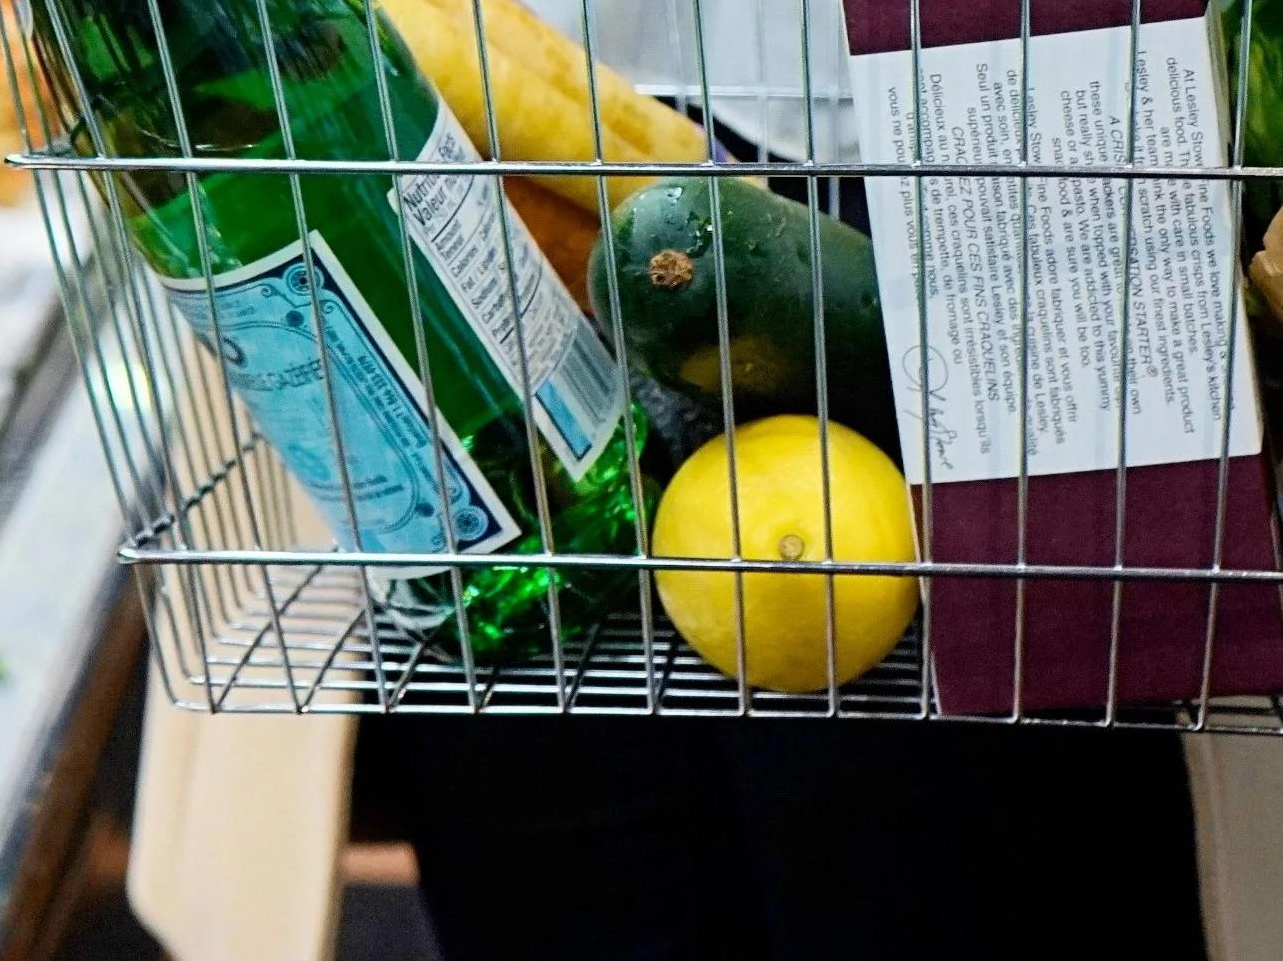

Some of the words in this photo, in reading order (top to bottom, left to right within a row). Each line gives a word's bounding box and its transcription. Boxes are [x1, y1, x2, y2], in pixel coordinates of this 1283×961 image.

[975, 62, 991, 92] Seul
[1006, 68, 1020, 86] de
[1166, 56, 1185, 113] delicious
[1182, 68, 1196, 82] At
[887, 86, 900, 117] vous
[929, 73, 948, 131] Délicieux
[980, 94, 991, 111] un
[993, 81, 1006, 111] avec
[1075, 89, 1089, 110] but
[1088, 80, 1105, 115] these
[1141, 95, 1154, 106] &
[1182, 85, 1202, 128] Lesley
[891, 119, 903, 136] ne
[1060, 89, 1078, 137] cheese
[1108, 114, 1122, 125] A
[1142, 108, 1157, 130] her
[915, 98, 939, 185] accompags
[937, 133, 949, 151] au
[980, 113, 1000, 159] produit
[995, 114, 1013, 145] soin,
[1075, 112, 1094, 147] really
[1091, 118, 1111, 162] unique
[1160, 125, 1172, 148] are
[1173, 115, 1189, 148] food.
[1001, 148, 1013, 165] en
[1029, 131, 1045, 164] Stow
[1051, 136, 1064, 165] snac
[1066, 139, 1077, 152] or
[1145, 133, 1162, 166] team
[1178, 149, 1195, 190] The
[411, 184, 450, 227] Valeur
[899, 189, 916, 217] plus
[930, 188, 944, 205] de
[973, 176, 993, 223] pouvait
[1087, 186, 1104, 221] when
[1101, 176, 1118, 219] ackers
[1138, 187, 1155, 234] scratch
[1168, 189, 1183, 216] with
[947, 203, 959, 227] ces
[960, 197, 978, 240] POUR
[1039, 205, 1056, 245] Foods
[1061, 208, 1074, 218] &
[1154, 203, 1169, 225] the
[1183, 192, 1202, 247] fabulous
[1200, 206, 1217, 246] Foods
[905, 220, 918, 249] vous
[930, 207, 953, 271] trempette,
[993, 209, 1014, 261] fabriqué
[1062, 221, 1074, 242] are
[1077, 218, 1091, 241] We
[1107, 221, 1119, 243] are
[1155, 227, 1173, 254] only
[1172, 218, 1185, 247] care
[948, 229, 970, 294] craquelins
[967, 242, 982, 273] CES
[982, 225, 1001, 282] satisfaire
[1027, 232, 1046, 286] fabuleux
[1066, 245, 1079, 274] sure
[1080, 243, 1092, 264] are
[1090, 224, 1110, 268] topped
[1142, 236, 1160, 271] using
[1176, 250, 1189, 262] in
[1205, 249, 1217, 268] we
[1044, 247, 1061, 284] adore
[1108, 245, 1126, 279] great
[1159, 256, 1174, 283] way
[1188, 248, 1207, 288] crisps
[923, 264, 939, 299] nous,
[941, 273, 955, 291] de
[971, 275, 987, 307] FINS
[1002, 264, 1016, 294] avec
[1067, 276, 1082, 300] you
[1083, 267, 1102, 321] addicted
[1098, 270, 1114, 296] with
[1149, 273, 1161, 294] our
[1165, 285, 1179, 298] to
[1178, 265, 1194, 299] small
[1208, 270, 1223, 298] love
[942, 293, 963, 346] fromage
[959, 296, 974, 324] sont
[988, 284, 1007, 326] Lesley
[1007, 296, 1022, 320] des
[1047, 287, 1069, 344] fabriquer
[1073, 302, 1088, 323] will
[1100, 299, 1115, 326] your
[1152, 297, 1168, 332] finest
[1167, 300, 1183, 336] make
[1195, 290, 1211, 319] from
[996, 328, 1009, 341] et
[1033, 288, 1055, 353] craquelins
[1076, 325, 1090, 342] be
[1090, 324, 1104, 337] to
[1182, 302, 1201, 356] batches.
[1209, 300, 1230, 347] making
[951, 347, 963, 365] ou
[976, 309, 1000, 402] CRAQUELINS
[998, 343, 1010, 367] son
[1025, 325, 1043, 370] cuisine
[1057, 346, 1071, 359] et
[1079, 345, 1093, 368] too.
[1093, 339, 1107, 362] this
[1172, 338, 1182, 348] a
[1197, 321, 1218, 373] Lesley's
[963, 326, 984, 396] irrésistibles
[1044, 355, 1059, 383] sont
[1059, 361, 1073, 392] vous
[1154, 334, 1178, 406] ingredients.
[1171, 350, 1189, 384] great
[999, 369, 1019, 416] équipe.
[1031, 372, 1045, 389] de
[1094, 365, 1111, 412] yummy
[1032, 392, 1051, 435] Lesley.
[1064, 394, 1079, 423] offrir
[1129, 389, 1141, 414] own
[1176, 386, 1196, 434] product
[1206, 375, 1224, 421] kitchen
[1046, 386, 1067, 445] fabriqués
